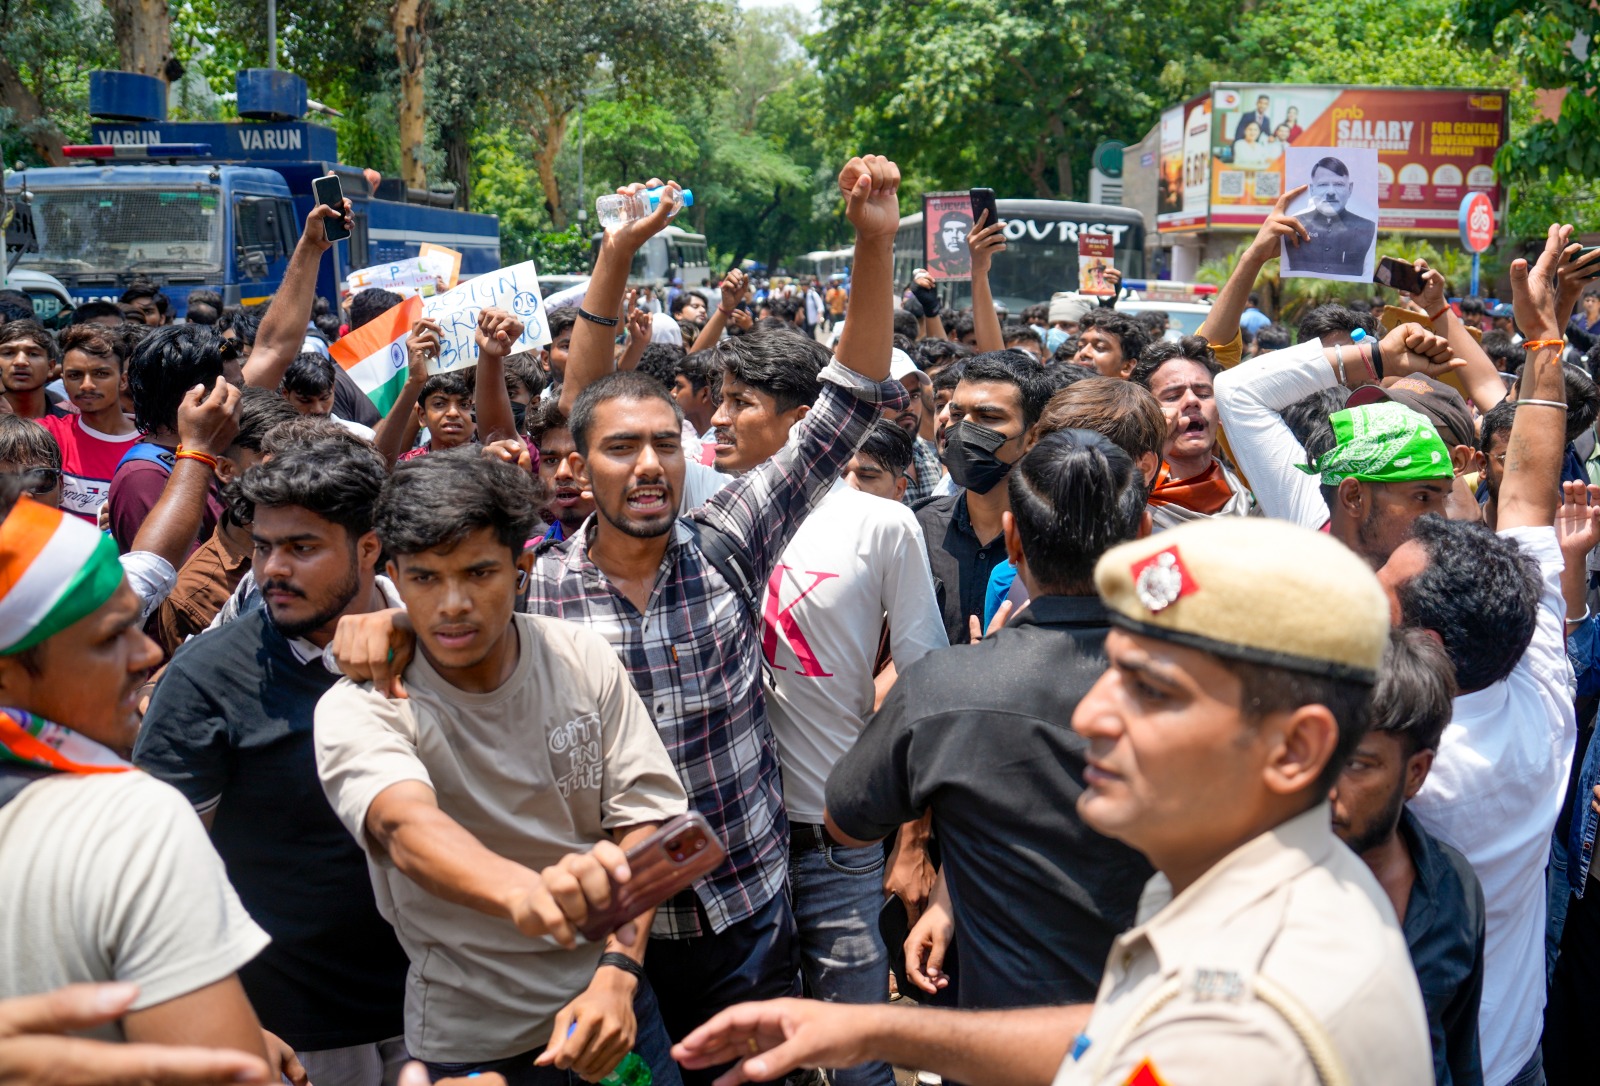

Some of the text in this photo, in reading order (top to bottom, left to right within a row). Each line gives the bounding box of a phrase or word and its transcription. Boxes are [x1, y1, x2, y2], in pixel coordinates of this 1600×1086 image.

[1332, 104, 1364, 120] pnb
[99, 129, 162, 145] VARUN
[1337, 119, 1414, 140] SALARY
[1431, 121, 1499, 135] FOR CENTRAL
[239, 128, 302, 150] VARUN
[1430, 134, 1499, 147] GOVERNMENT
[760, 564, 840, 675] K
[556, 761, 603, 798] THE
